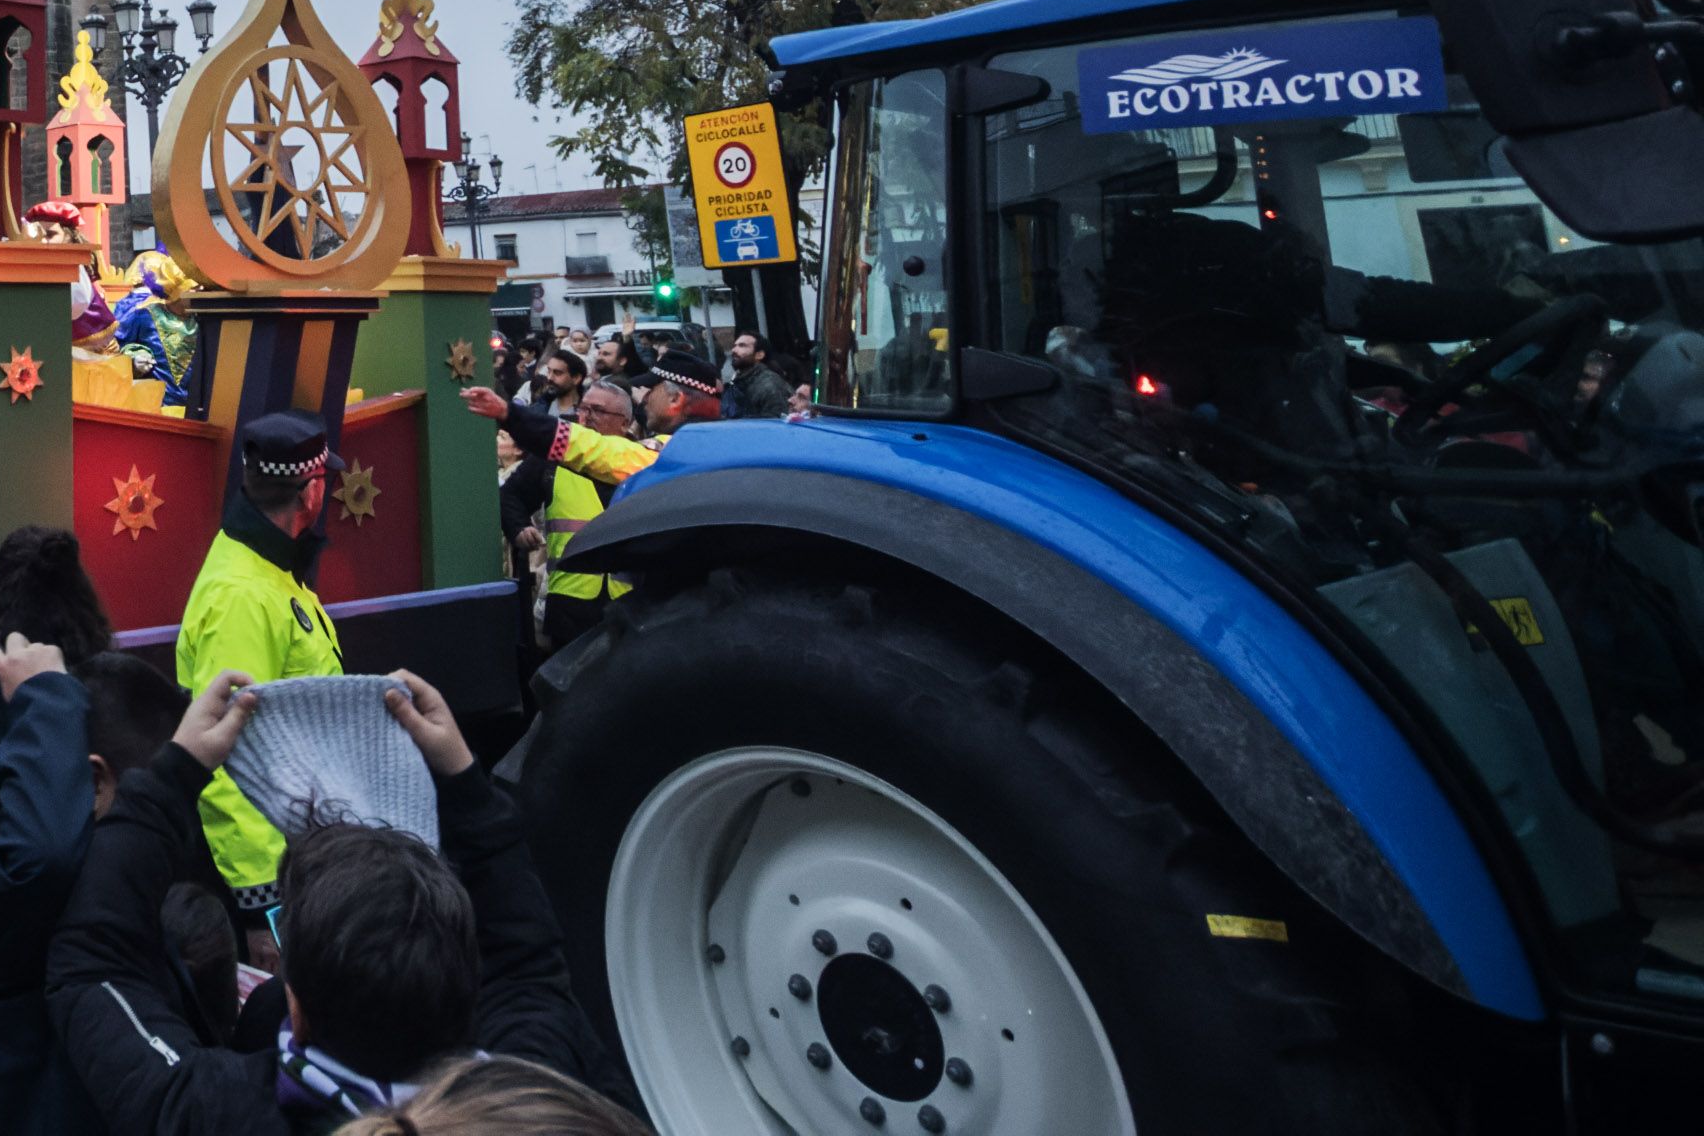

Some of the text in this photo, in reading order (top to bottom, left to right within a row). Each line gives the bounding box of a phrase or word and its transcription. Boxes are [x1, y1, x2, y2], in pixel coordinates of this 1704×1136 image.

[1107, 67, 1421, 119] ECOTRACTOR
[699, 109, 759, 129] ATENCIÓN
[696, 122, 766, 143] CICLOCALLE
[723, 156, 747, 174] 20
[708, 189, 773, 206] PRIORIDAD
[715, 203, 769, 217] CICLISTA
